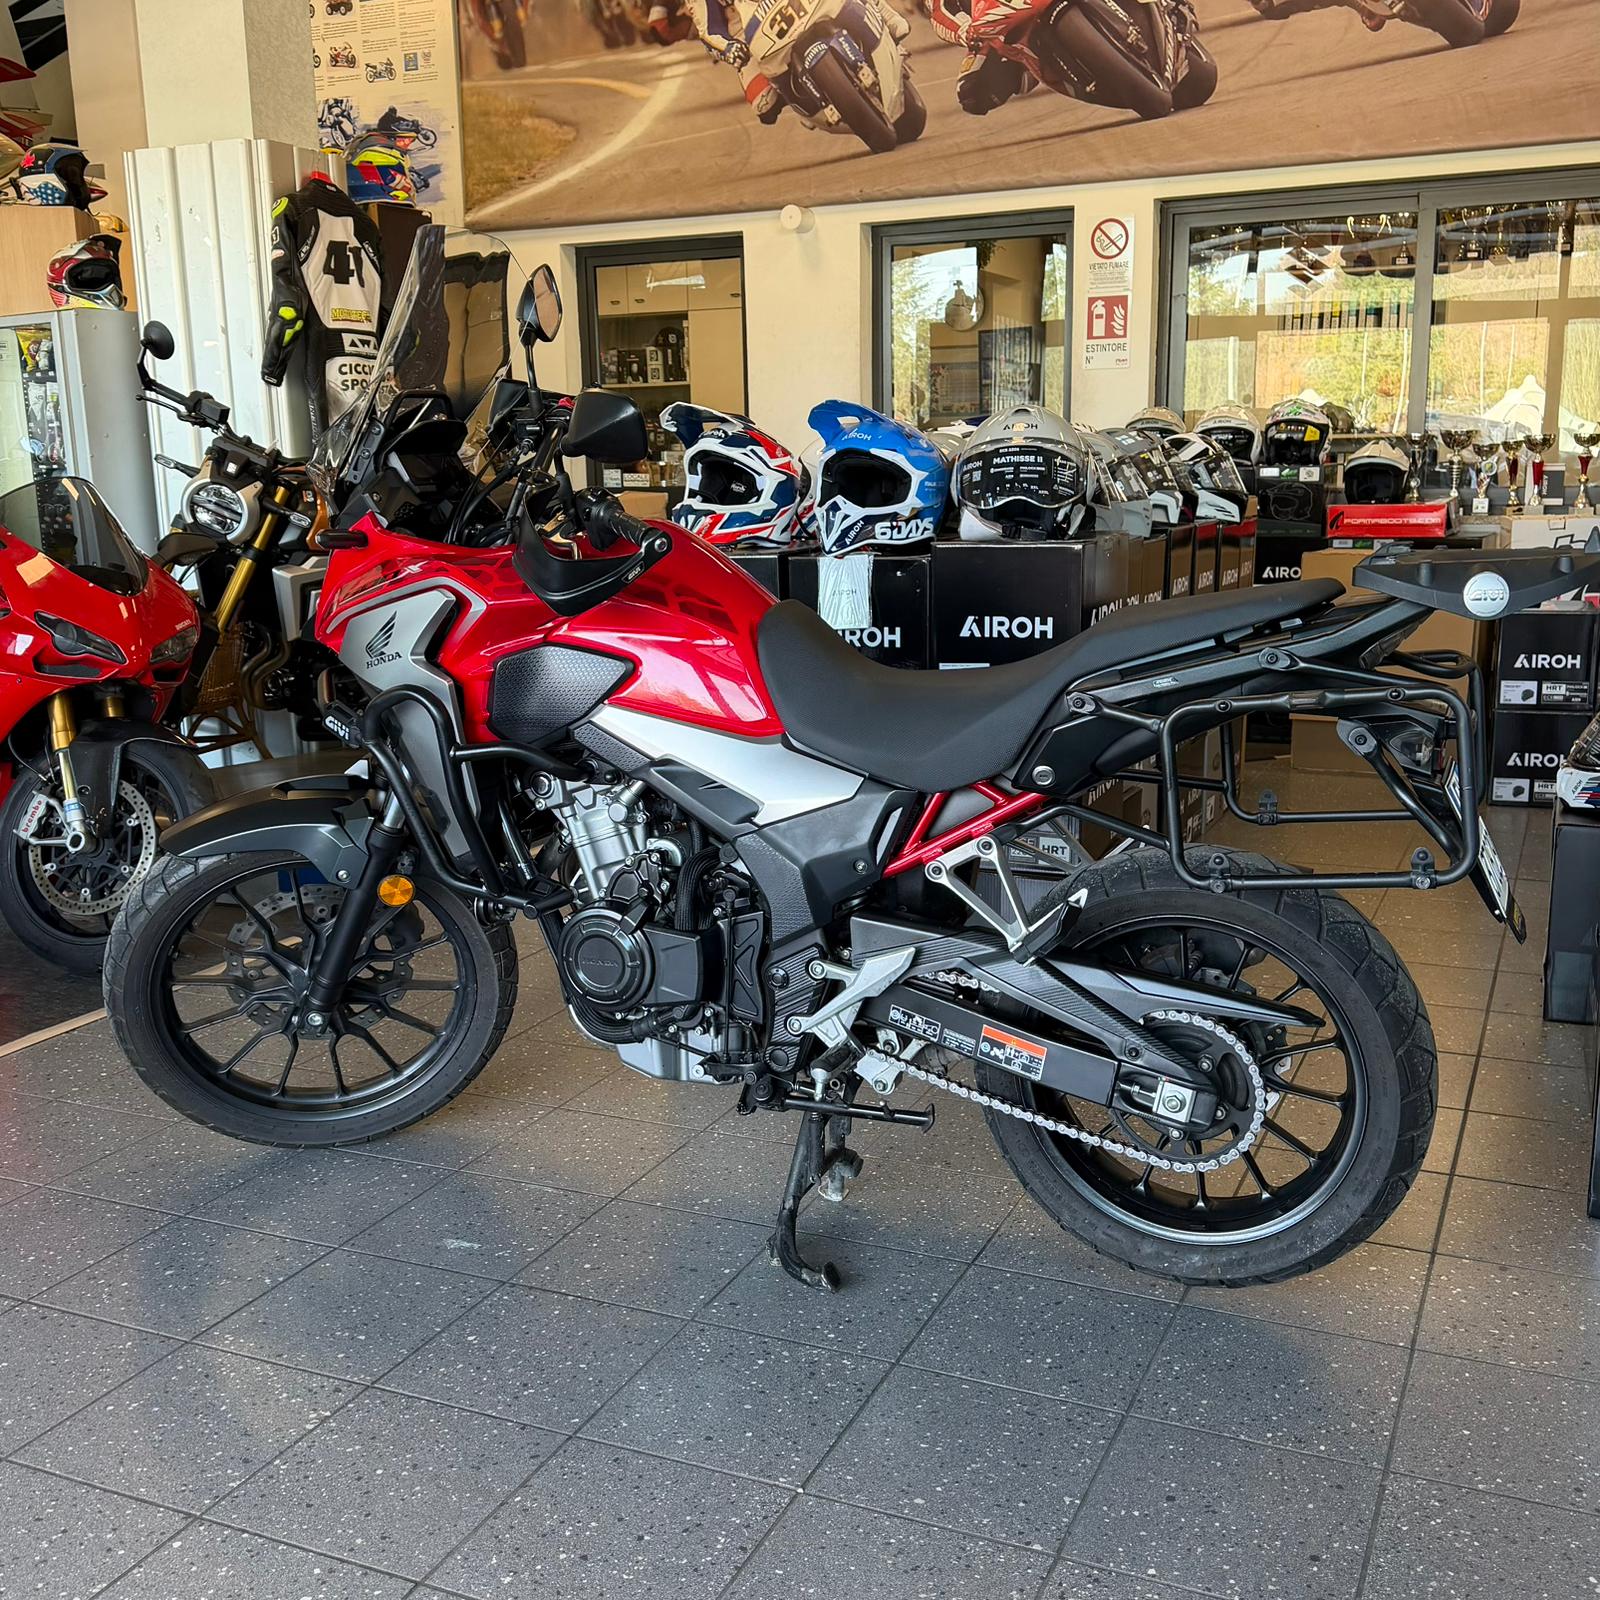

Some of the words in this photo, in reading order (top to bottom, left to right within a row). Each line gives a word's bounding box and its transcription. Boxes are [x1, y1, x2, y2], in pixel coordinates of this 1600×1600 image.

[1086, 343, 1128, 353] ESTINTORE
[993, 455, 1036, 464] MATHISSE
[844, 519, 865, 545] AIROH
[1262, 566, 1302, 579] AIRO
[959, 615, 1054, 639] AIROH
[366, 651, 402, 669] HONDA
[1513, 654, 1581, 669] AIROH
[325, 715, 349, 740] GIVI
[22, 799, 44, 834] brembo
[1042, 844, 1068, 856] HRT
